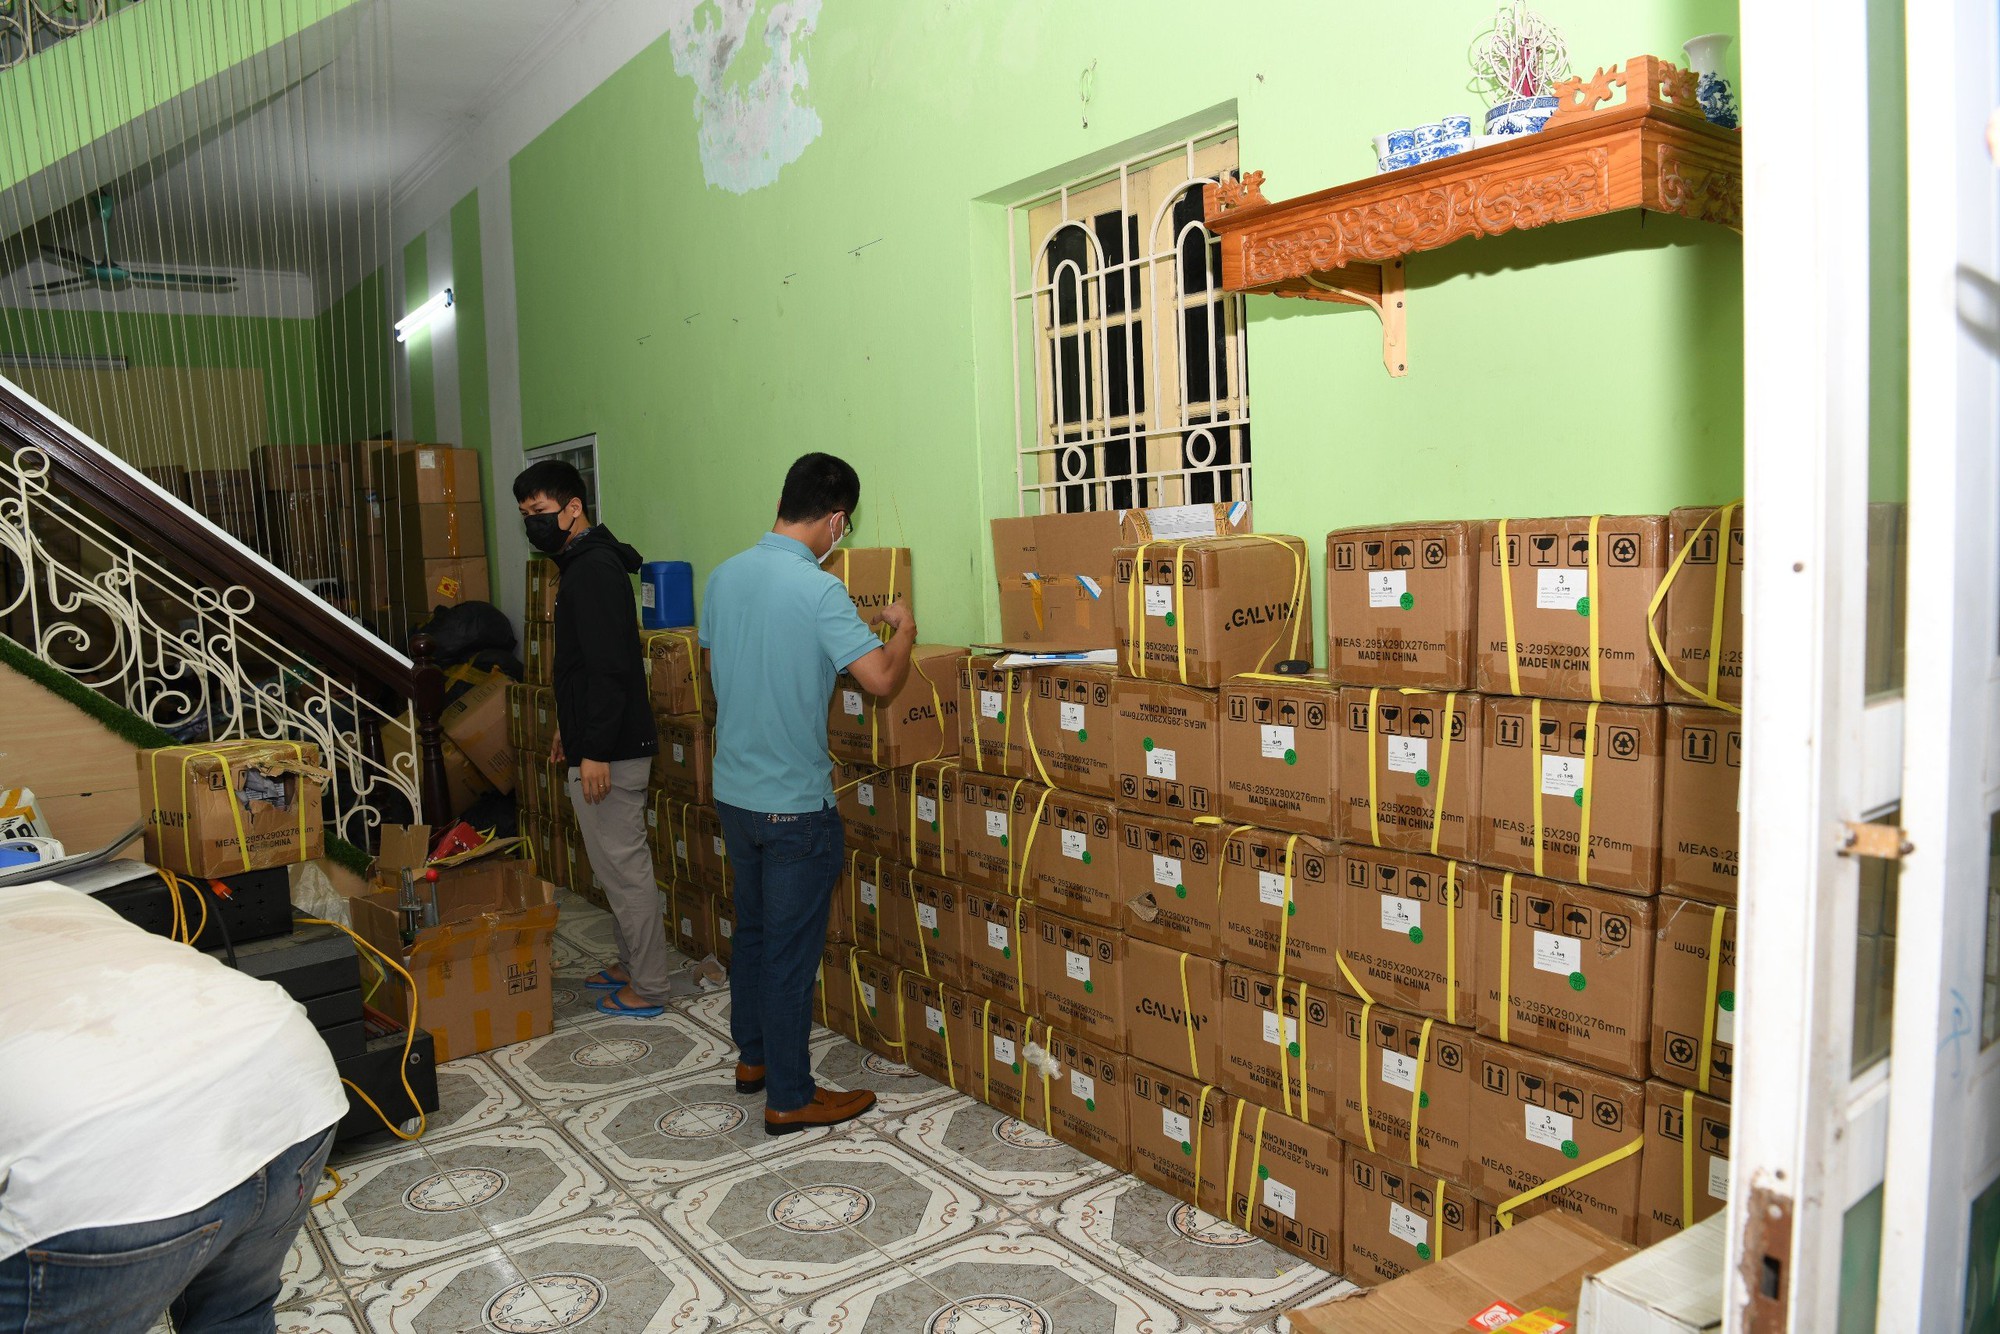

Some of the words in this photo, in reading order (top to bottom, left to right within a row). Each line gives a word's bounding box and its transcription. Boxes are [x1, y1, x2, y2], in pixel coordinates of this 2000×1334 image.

[1335, 638, 1446, 652] MEAS:295X290X276mm
[1490, 642, 1635, 660] MES:295X290X76mm
[1155, 652, 1160, 660] IN
[1161, 653, 1179, 662] CHINA
[1358, 650, 1380, 661] MADE
[1382, 651, 1390, 661] IN
[1392, 651, 1418, 662] CHINA
[1519, 657, 1548, 669] MADE
[1550, 659, 1560, 670] IN
[1563, 659, 1591, 671] CHIN
[1139, 703, 1159, 713] CHINA
[1160, 705, 1167, 714] IN
[1170, 705, 1187, 716] MADE
[1052, 760, 1067, 770] MADE
[1074, 764, 1090, 775] CHINA
[1248, 795, 1268, 806] MADE
[1270, 799, 1277, 807] IN
[1278, 800, 1301, 812] CHINA
[1350, 797, 1464, 823] MEA:295X290X26mm
[1398, 815, 1406, 825] IN
[1408, 817, 1434, 830] CHINA
[1492, 818, 1632, 852] MEAS:25X290276mm
[1520, 836, 1548, 851] MAE
[1550, 840, 1560, 853] IN
[1563, 844, 1595, 859] CHIA
[1172, 921, 1191, 933] CHINA
[1248, 938, 1268, 950] MADE
[1270, 943, 1277, 952] IN
[1368, 967, 1391, 982] MADE
[1393, 972, 1401, 984] IN
[1403, 975, 1430, 991] CHINA
[1489, 990, 1626, 1037] MAS:295X290X276mm
[1517, 1010, 1545, 1026] MADE
[1546, 1015, 1556, 1028] IN
[1559, 1019, 1590, 1040] CHINA
[1250, 1072, 1268, 1085] MADE
[1270, 1080, 1277, 1089] IN
[1345, 1099, 1459, 1148] MES:295X29X276mm
[1369, 1118, 1391, 1133] MADE
[1393, 1129, 1401, 1138] IN
[1261, 1130, 1278, 1143] CHIN
[1280, 1138, 1287, 1148] IN
[1288, 1141, 1308, 1157] MADE
[1552, 1194, 1583, 1214] CHINA
